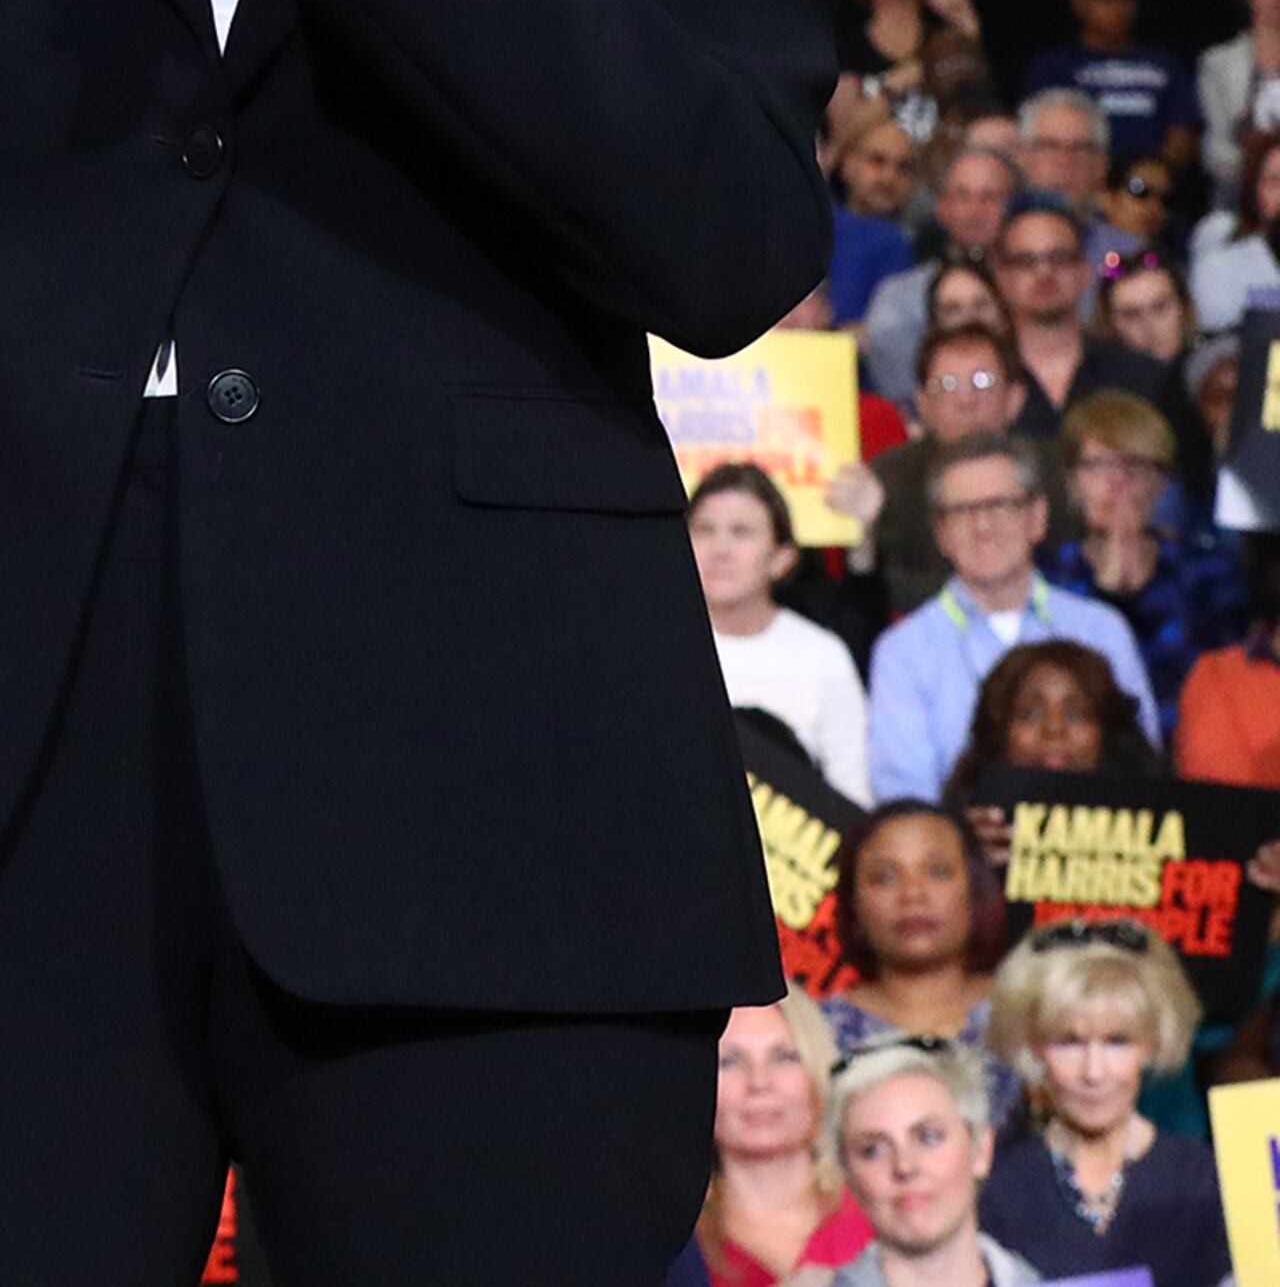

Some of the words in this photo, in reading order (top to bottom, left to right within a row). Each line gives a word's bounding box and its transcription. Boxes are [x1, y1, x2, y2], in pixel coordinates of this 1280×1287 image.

[1011, 801, 1186, 860] KAMALA
[1004, 852, 1161, 908] HARRIS
[1159, 859, 1241, 910] FOR
